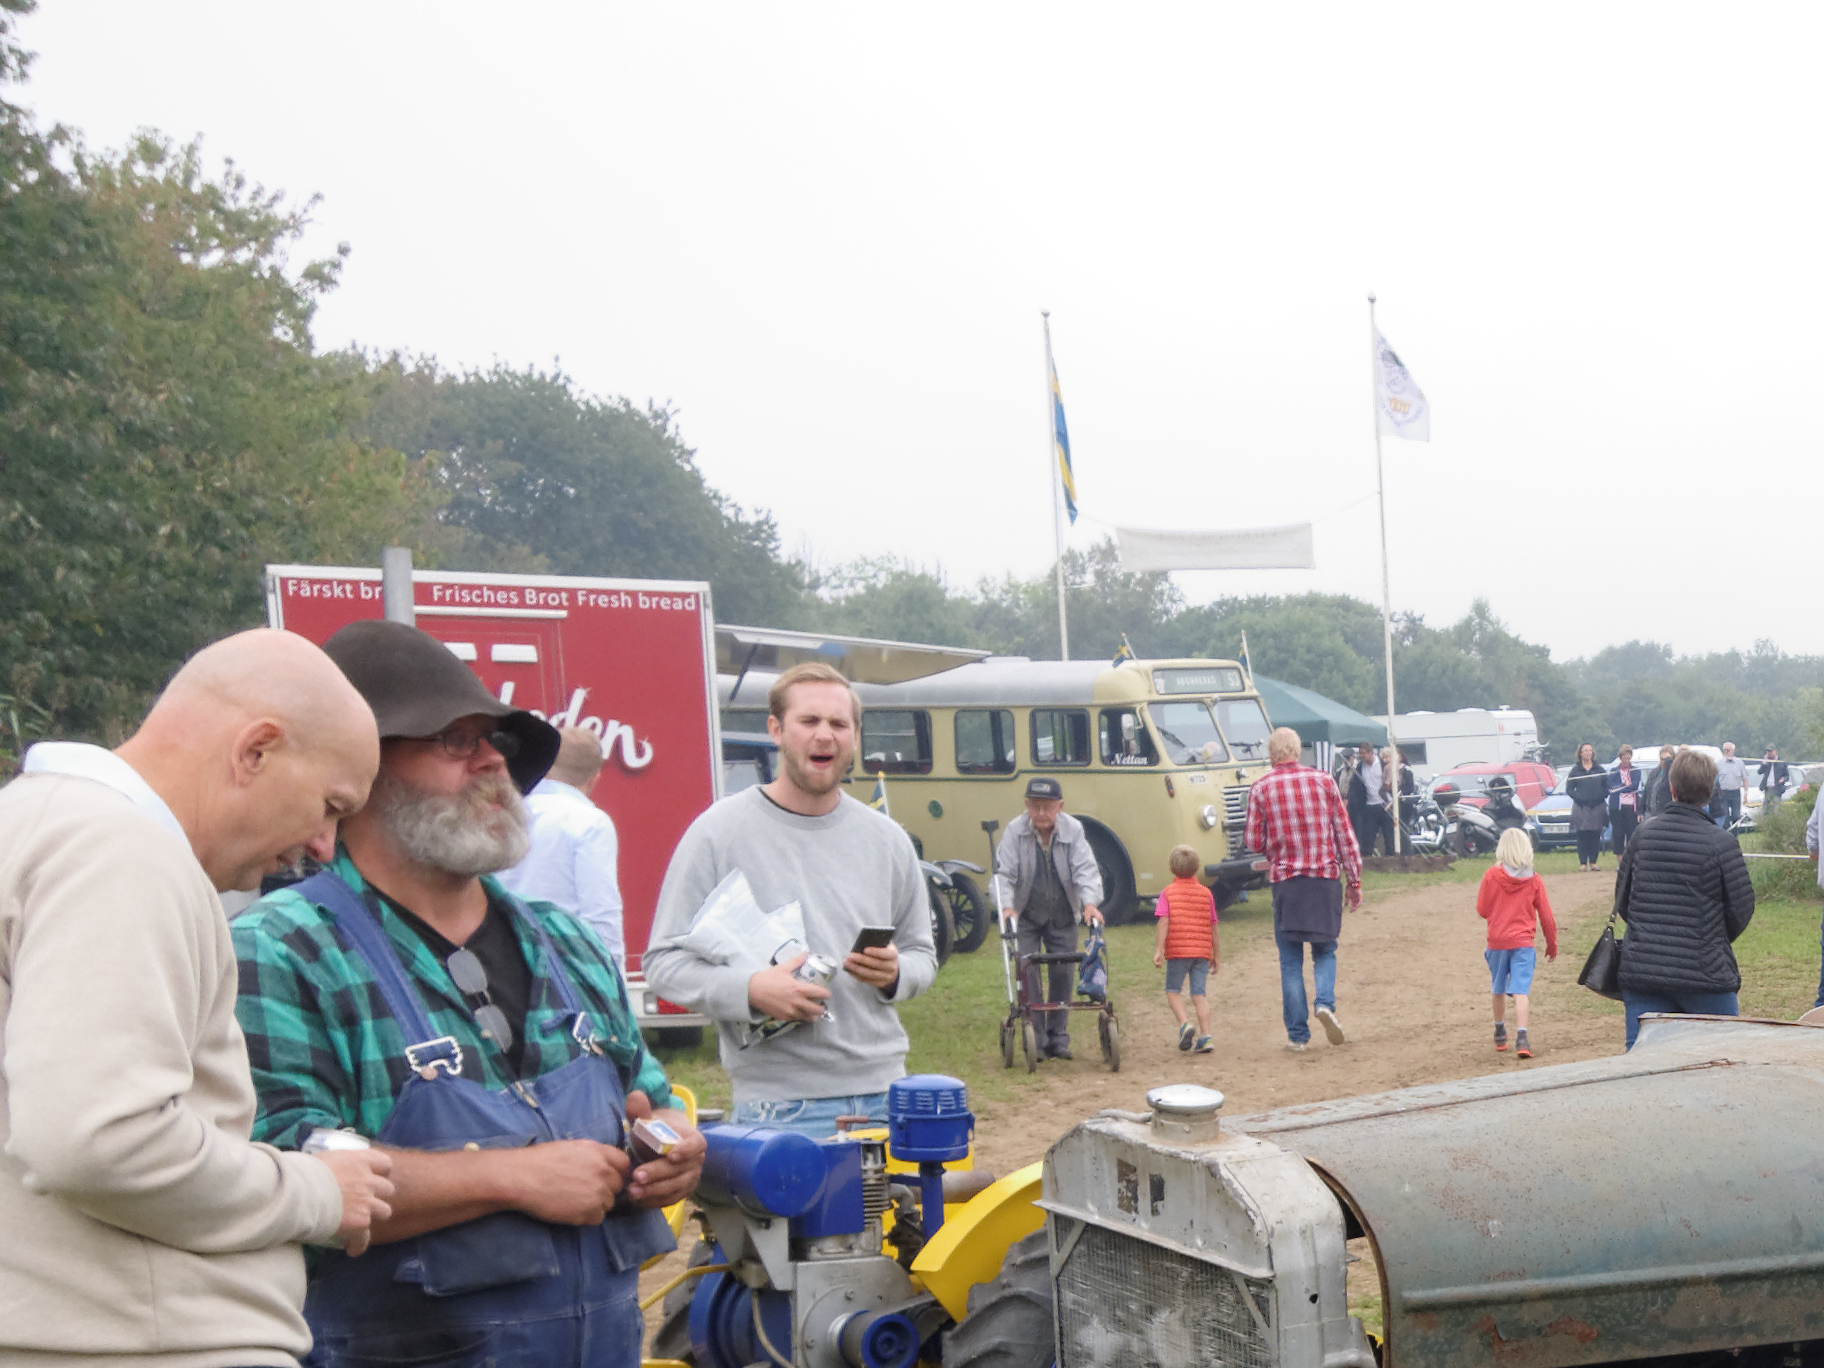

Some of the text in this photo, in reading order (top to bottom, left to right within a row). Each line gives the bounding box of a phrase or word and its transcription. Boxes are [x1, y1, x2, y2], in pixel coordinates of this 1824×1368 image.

[287, 579, 696, 611] Färskt br Frisches Brot Fresh bread
